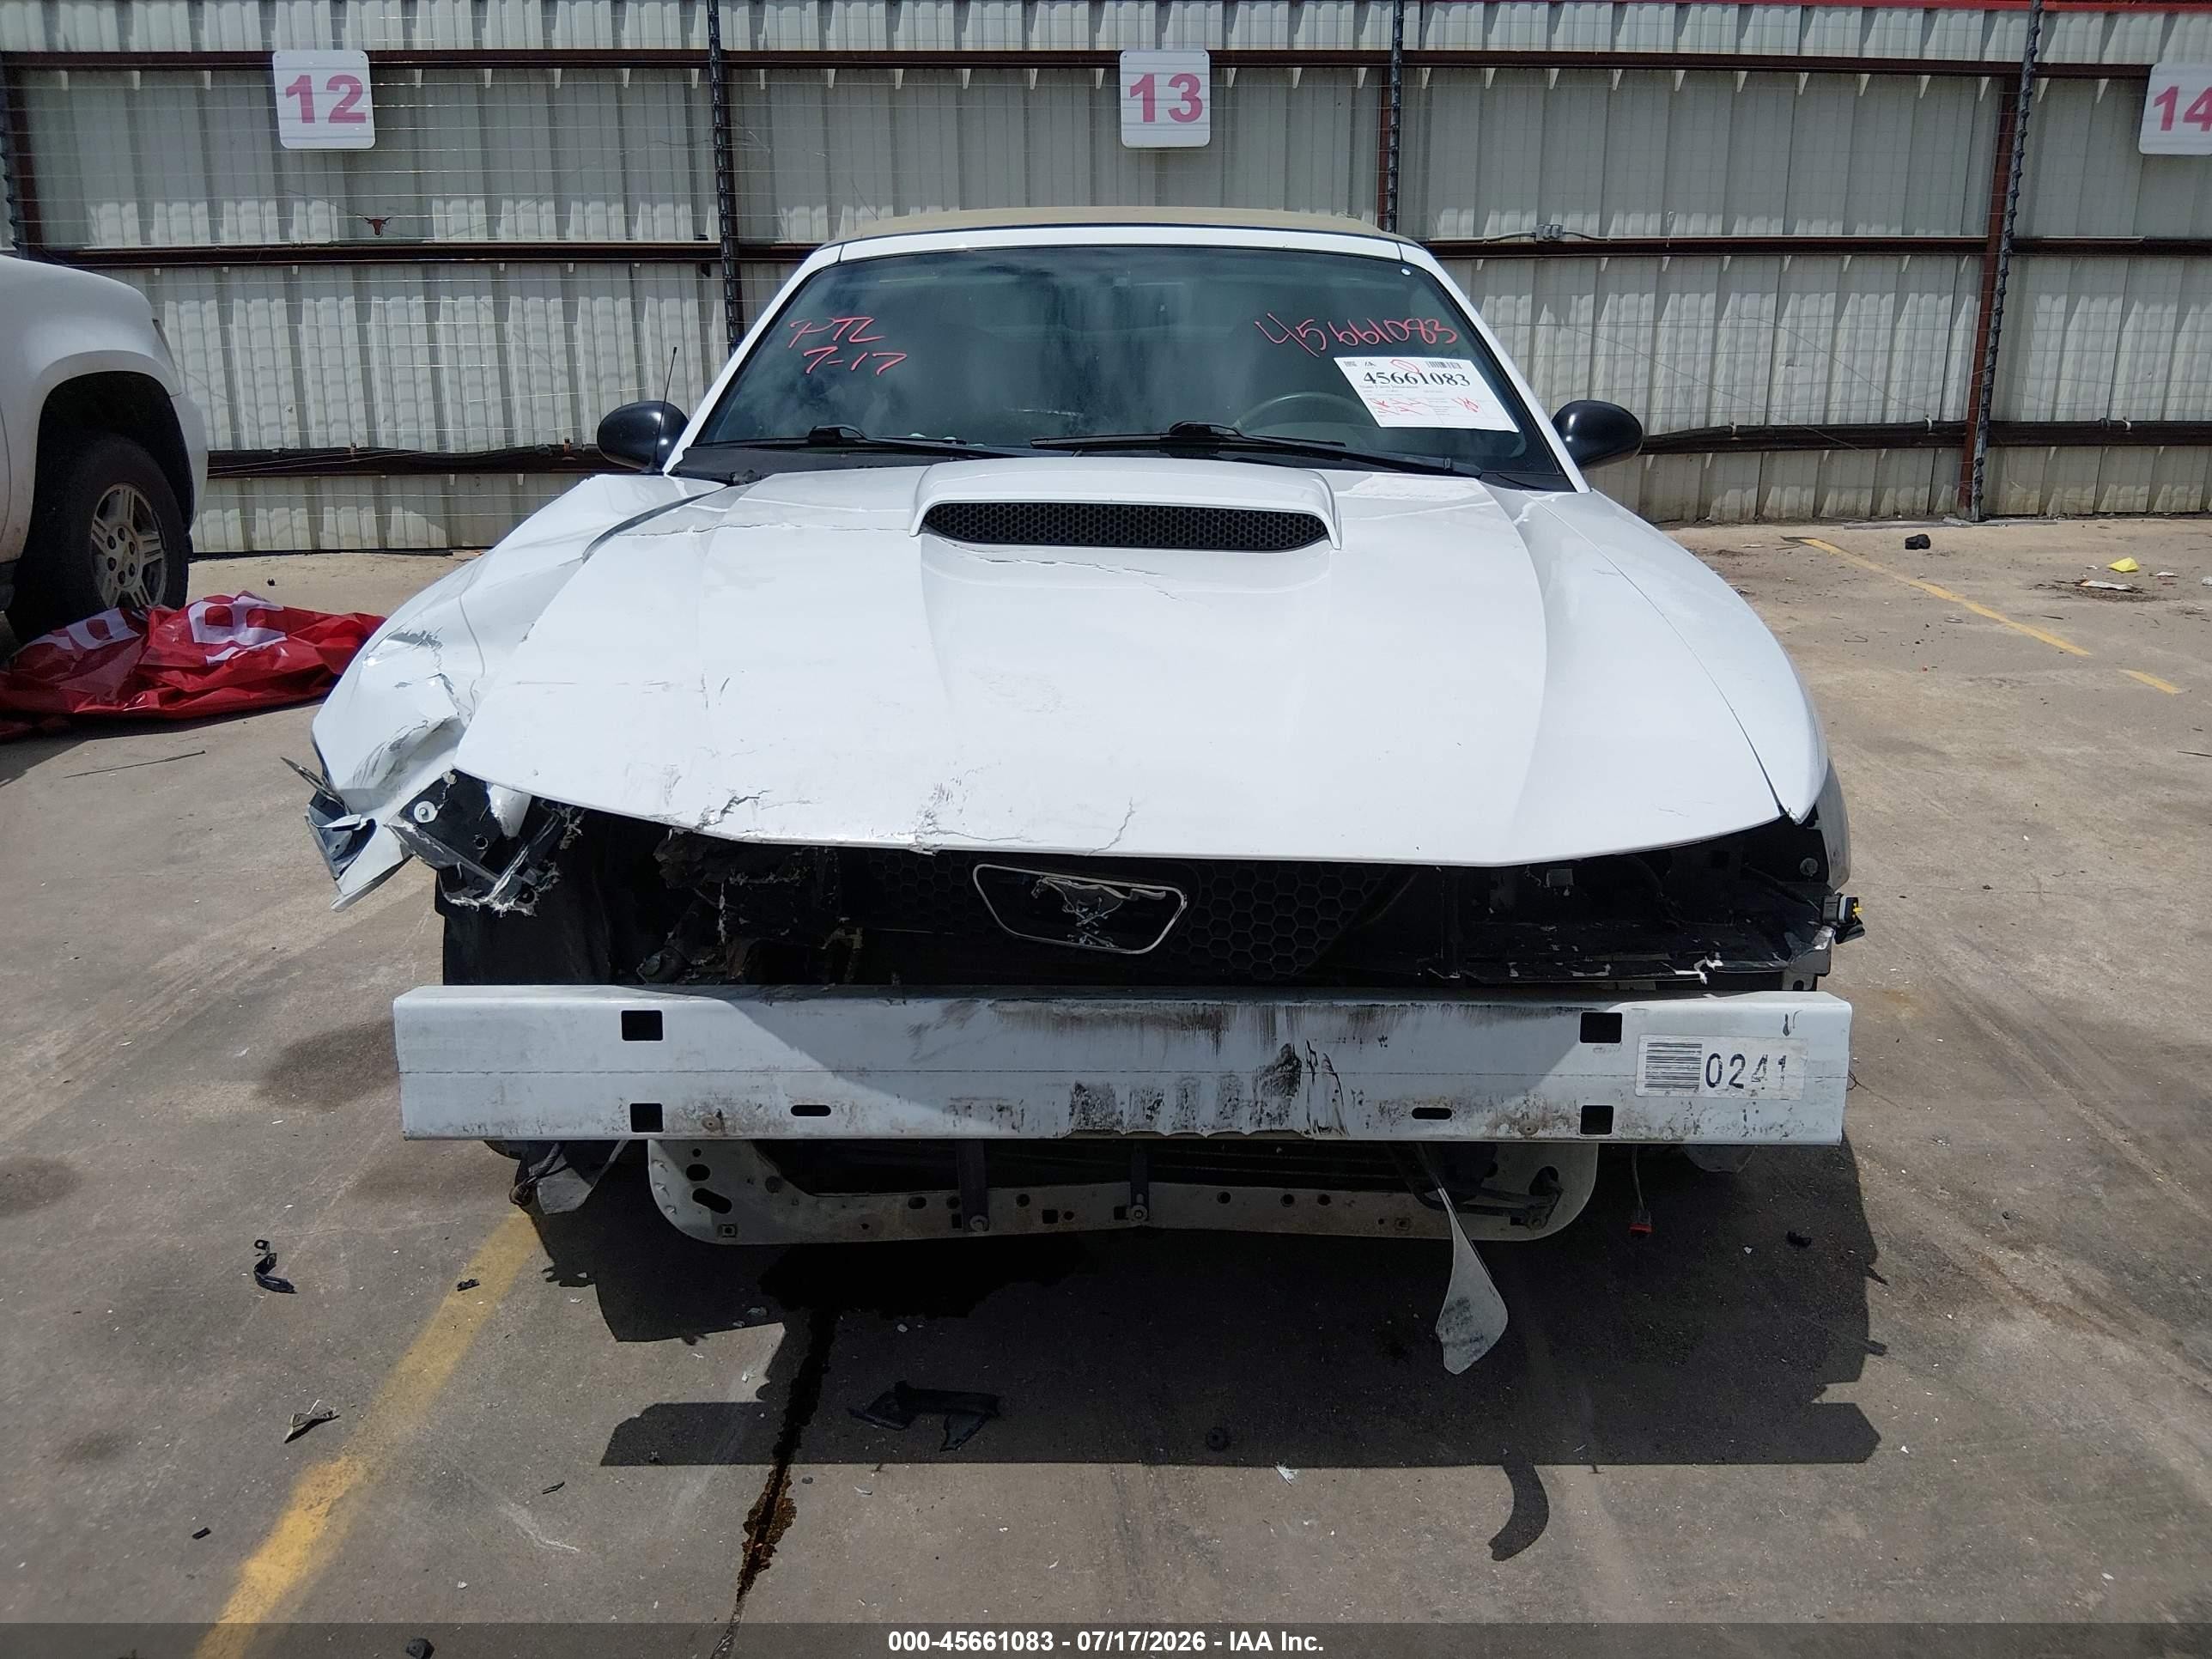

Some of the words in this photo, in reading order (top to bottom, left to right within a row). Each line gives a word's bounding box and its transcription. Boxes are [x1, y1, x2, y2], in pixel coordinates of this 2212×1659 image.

[285, 74, 367, 124] 12
[1129, 73, 1203, 123] 13
[2154, 86, 2212, 131] 14
[803, 345, 908, 376] 7-17
[1363, 371, 1471, 386] 45661083
